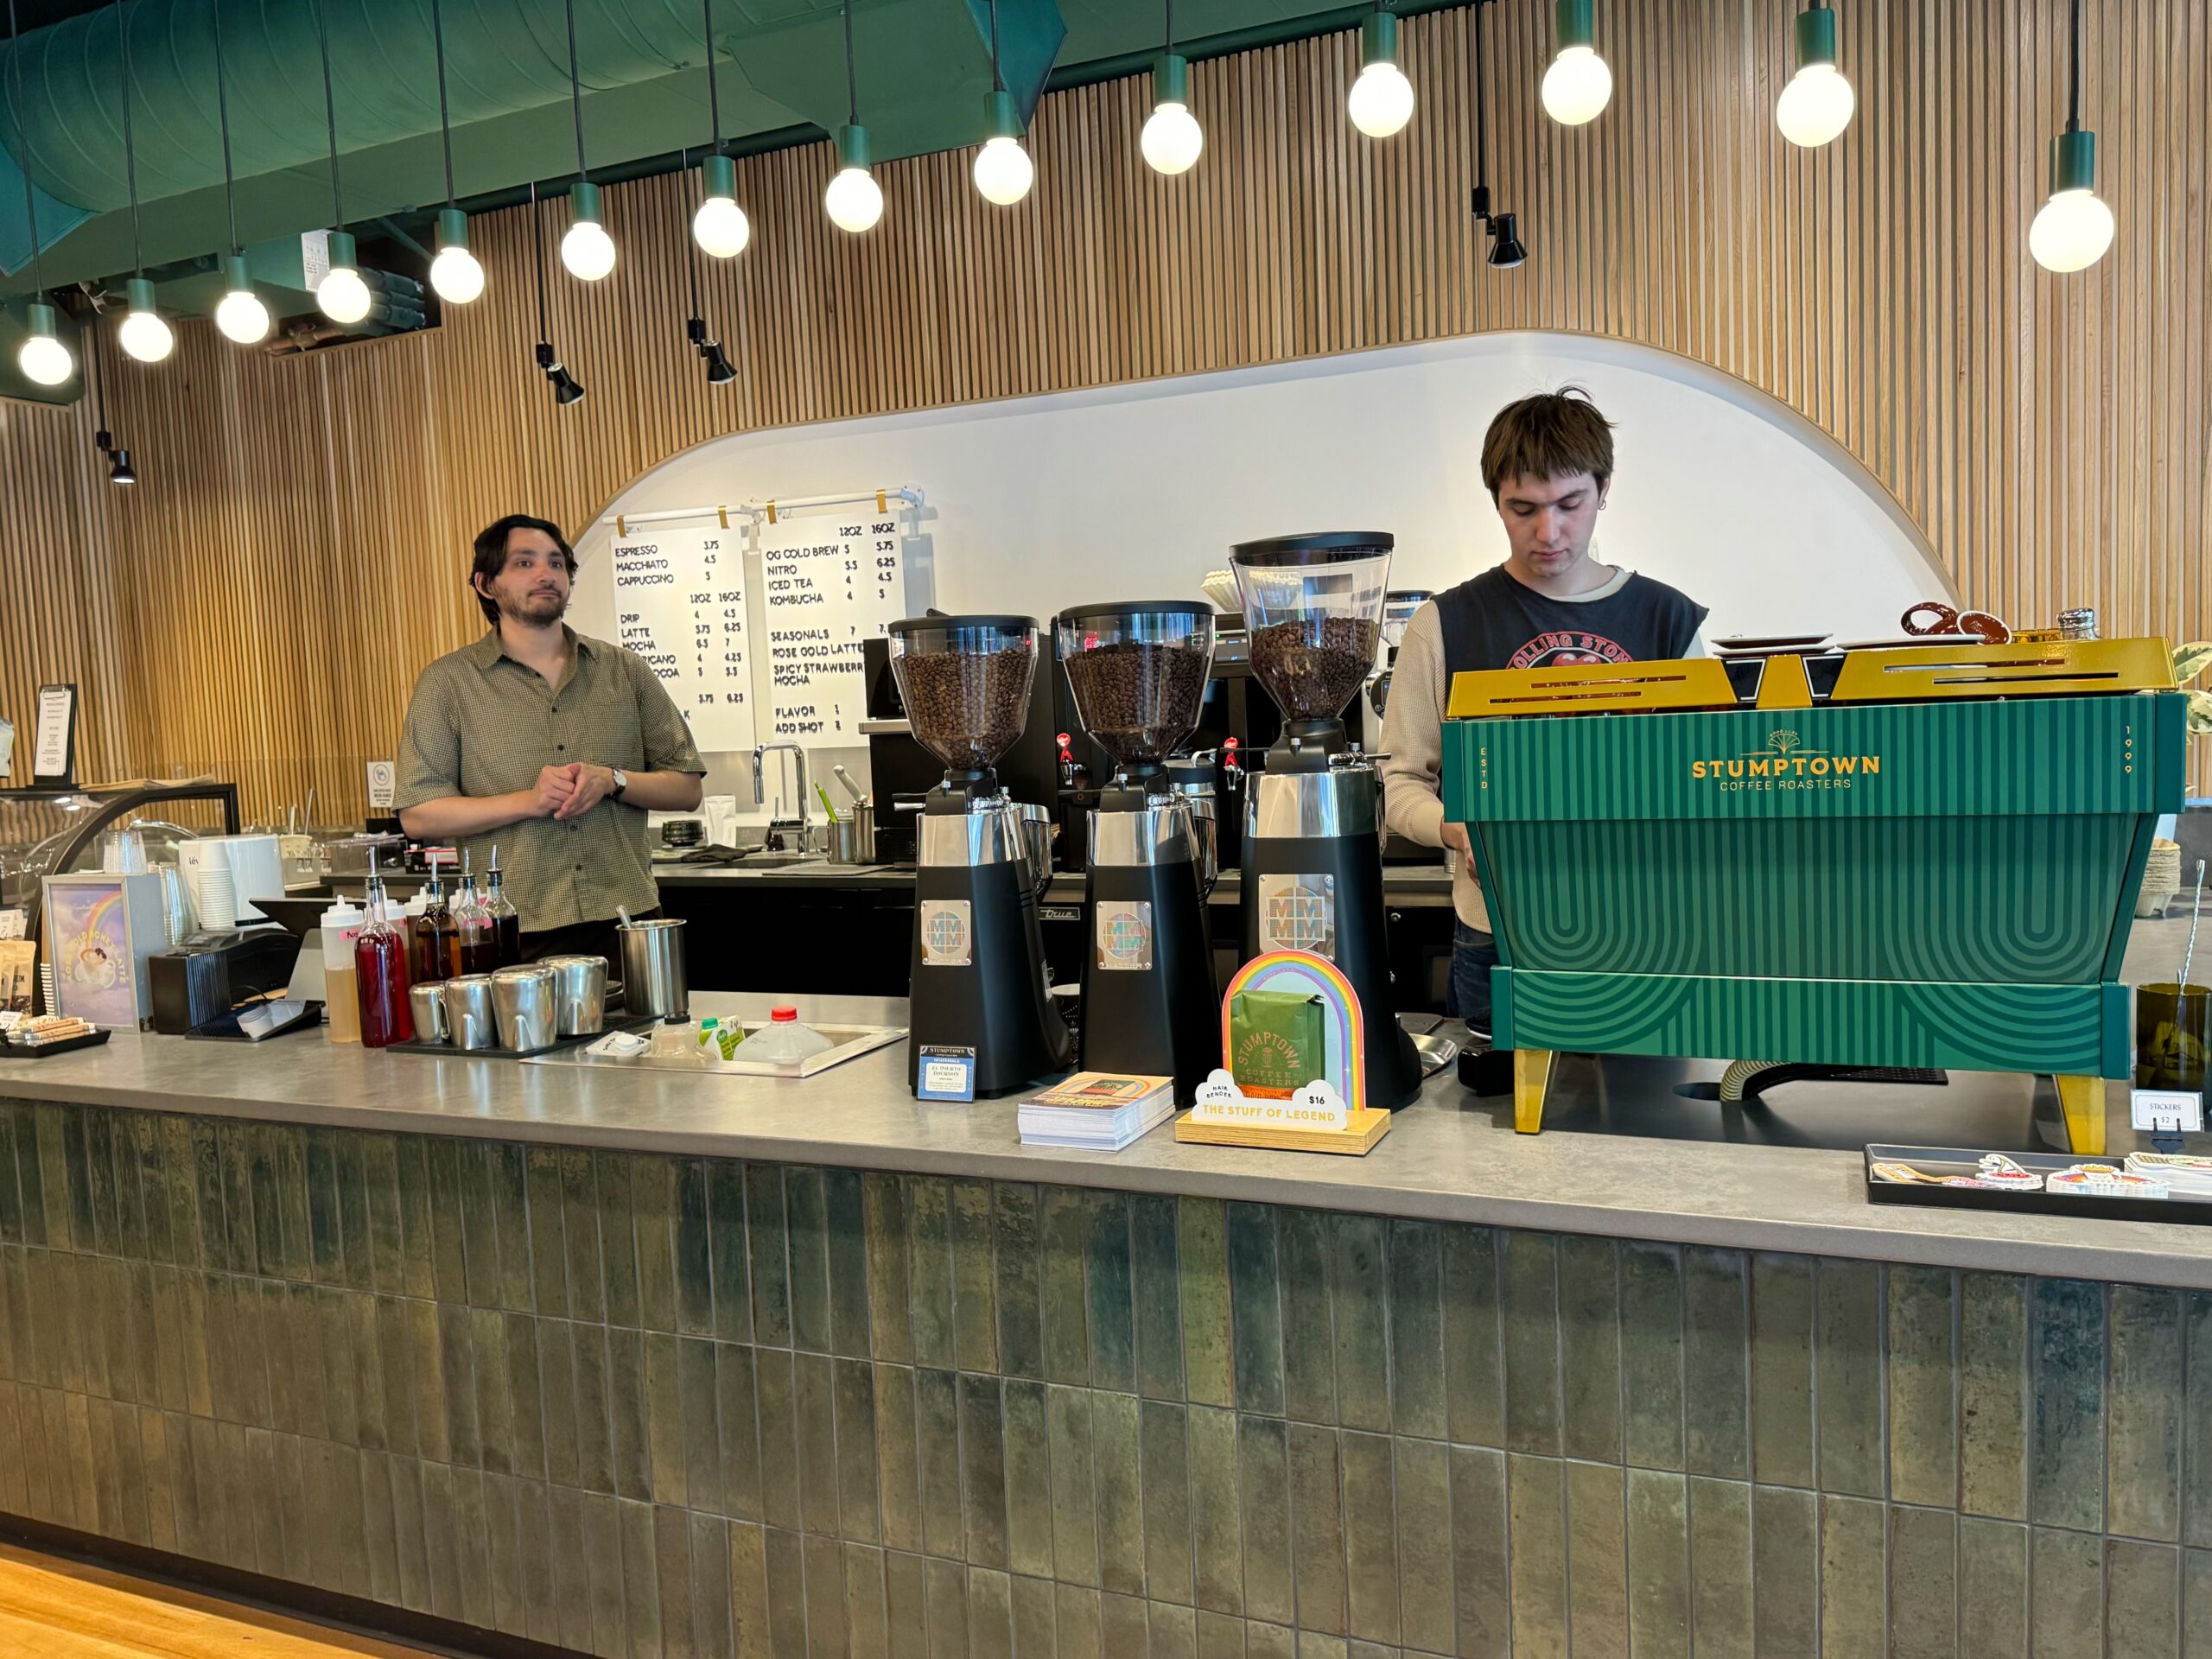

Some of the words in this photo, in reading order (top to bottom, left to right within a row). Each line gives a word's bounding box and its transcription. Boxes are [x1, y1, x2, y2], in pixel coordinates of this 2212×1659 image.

[840, 526, 862, 536] 12OZ
[872, 523, 895, 534] 16OZ
[615, 545, 658, 556] ESPRESSO
[766, 550, 780, 560] OG
[784, 548, 810, 559] COLD
[813, 545, 838, 556] BREW
[844, 544, 849, 554] 5
[876, 541, 893, 551] 5.75
[616, 559, 668, 572] MACCHIATO
[767, 565, 797, 575] NITRO
[845, 560, 857, 570] 5.5
[877, 557, 895, 568] 6.25
[617, 575, 674, 586] CAPPUCCINO
[706, 571, 710, 581] 5
[769, 580, 790, 590] ICED
[794, 578, 812, 588] TEA
[846, 575, 851, 584] 4
[878, 572, 892, 582] 4.5
[690, 594, 711, 603] 12OZ
[719, 592, 741, 602] 16OZ
[769, 593, 823, 606] KOMBUCHA
[847, 591, 852, 600] 4
[880, 588, 885, 599] 5
[620, 613, 639, 624] DRIP
[694, 610, 700, 619] 4
[621, 627, 650, 639] LATTE
[771, 629, 830, 642] SEASONALS
[850, 626, 855, 636] 7
[622, 640, 656, 652] MOCHA
[726, 638, 729, 647] 7
[772, 648, 797, 658] ROSE
[801, 646, 829, 657] GOLD
[831, 643, 864, 654] LATTE
[1512, 634, 1573, 669] OLLING
[1580, 635, 1629, 664] STON
[653, 668, 679, 678] OCOA
[774, 664, 801, 675] SPICY
[804, 662, 864, 674] STRAWBERR
[774, 675, 810, 686] MOCHA
[775, 706, 816, 718] FLAVOR
[775, 722, 796, 734] ADD
[798, 721, 823, 734] SHOT
[1692, 756, 1880, 779] STUMPTOWN
[1720, 781, 1771, 791] COFFEE
[1778, 779, 1852, 790] ROASTERS
[1040, 909, 1075, 918] True
[1238, 1032, 1300, 1069] STUMPTOWN
[1246, 1069, 1291, 1078] COFFEE
[1241, 1076, 1300, 1085] ROASTERS
[1309, 1096, 1325, 1104] $16
[1203, 1105, 1224, 1115] THE
[1228, 1106, 1263, 1117] STUFF
[1267, 1109, 1282, 1118] OF
[1286, 1109, 1335, 1122] LEGEND
[2150, 1103, 2181, 1111] STICKERS
